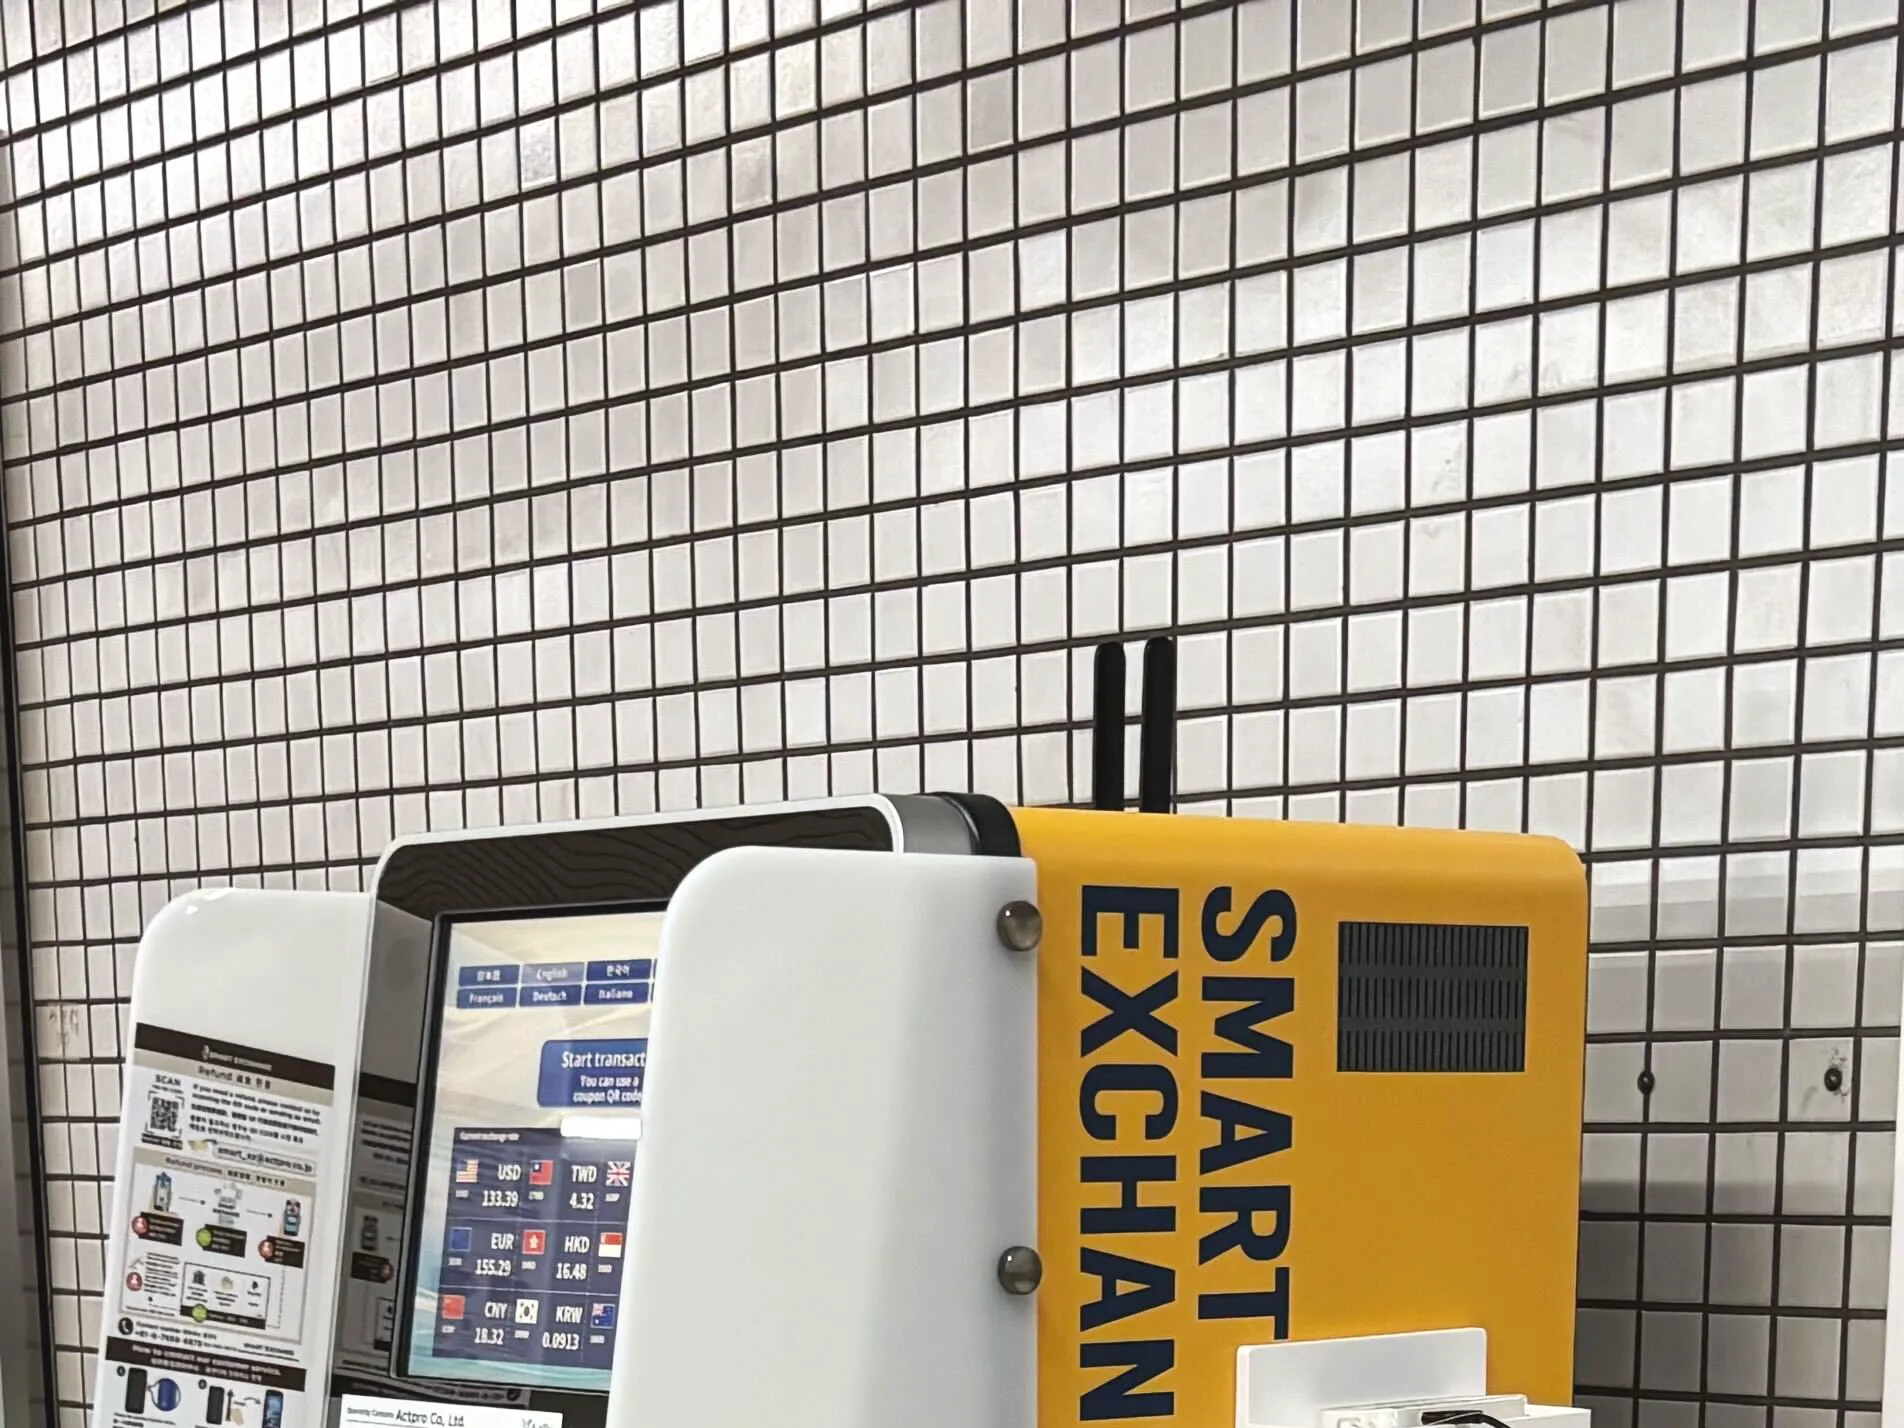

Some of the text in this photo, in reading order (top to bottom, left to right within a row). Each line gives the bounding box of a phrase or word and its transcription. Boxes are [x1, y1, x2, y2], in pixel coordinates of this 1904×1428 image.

[562, 1051, 645, 1068] Start transact
[155, 1074, 181, 1087] SCAN
[581, 1075, 639, 1088] You can use a
[607, 1089, 620, 1103] QR
[1197, 885, 1297, 1339] SMART
[498, 1164, 521, 1180] USD
[571, 1165, 597, 1182] TWD
[482, 1190, 518, 1207] 133.39
[569, 1192, 594, 1210] 4.32
[491, 1233, 514, 1250] EUR
[564, 1236, 590, 1253] HKD
[475, 1259, 511, 1276] 155.29
[485, 1302, 508, 1319] CNY
[556, 1306, 583, 1324] KRW
[474, 1327, 504, 1345] 18.32
[542, 1332, 580, 1350] 0.0913
[396, 1410, 427, 1425] Actpro
